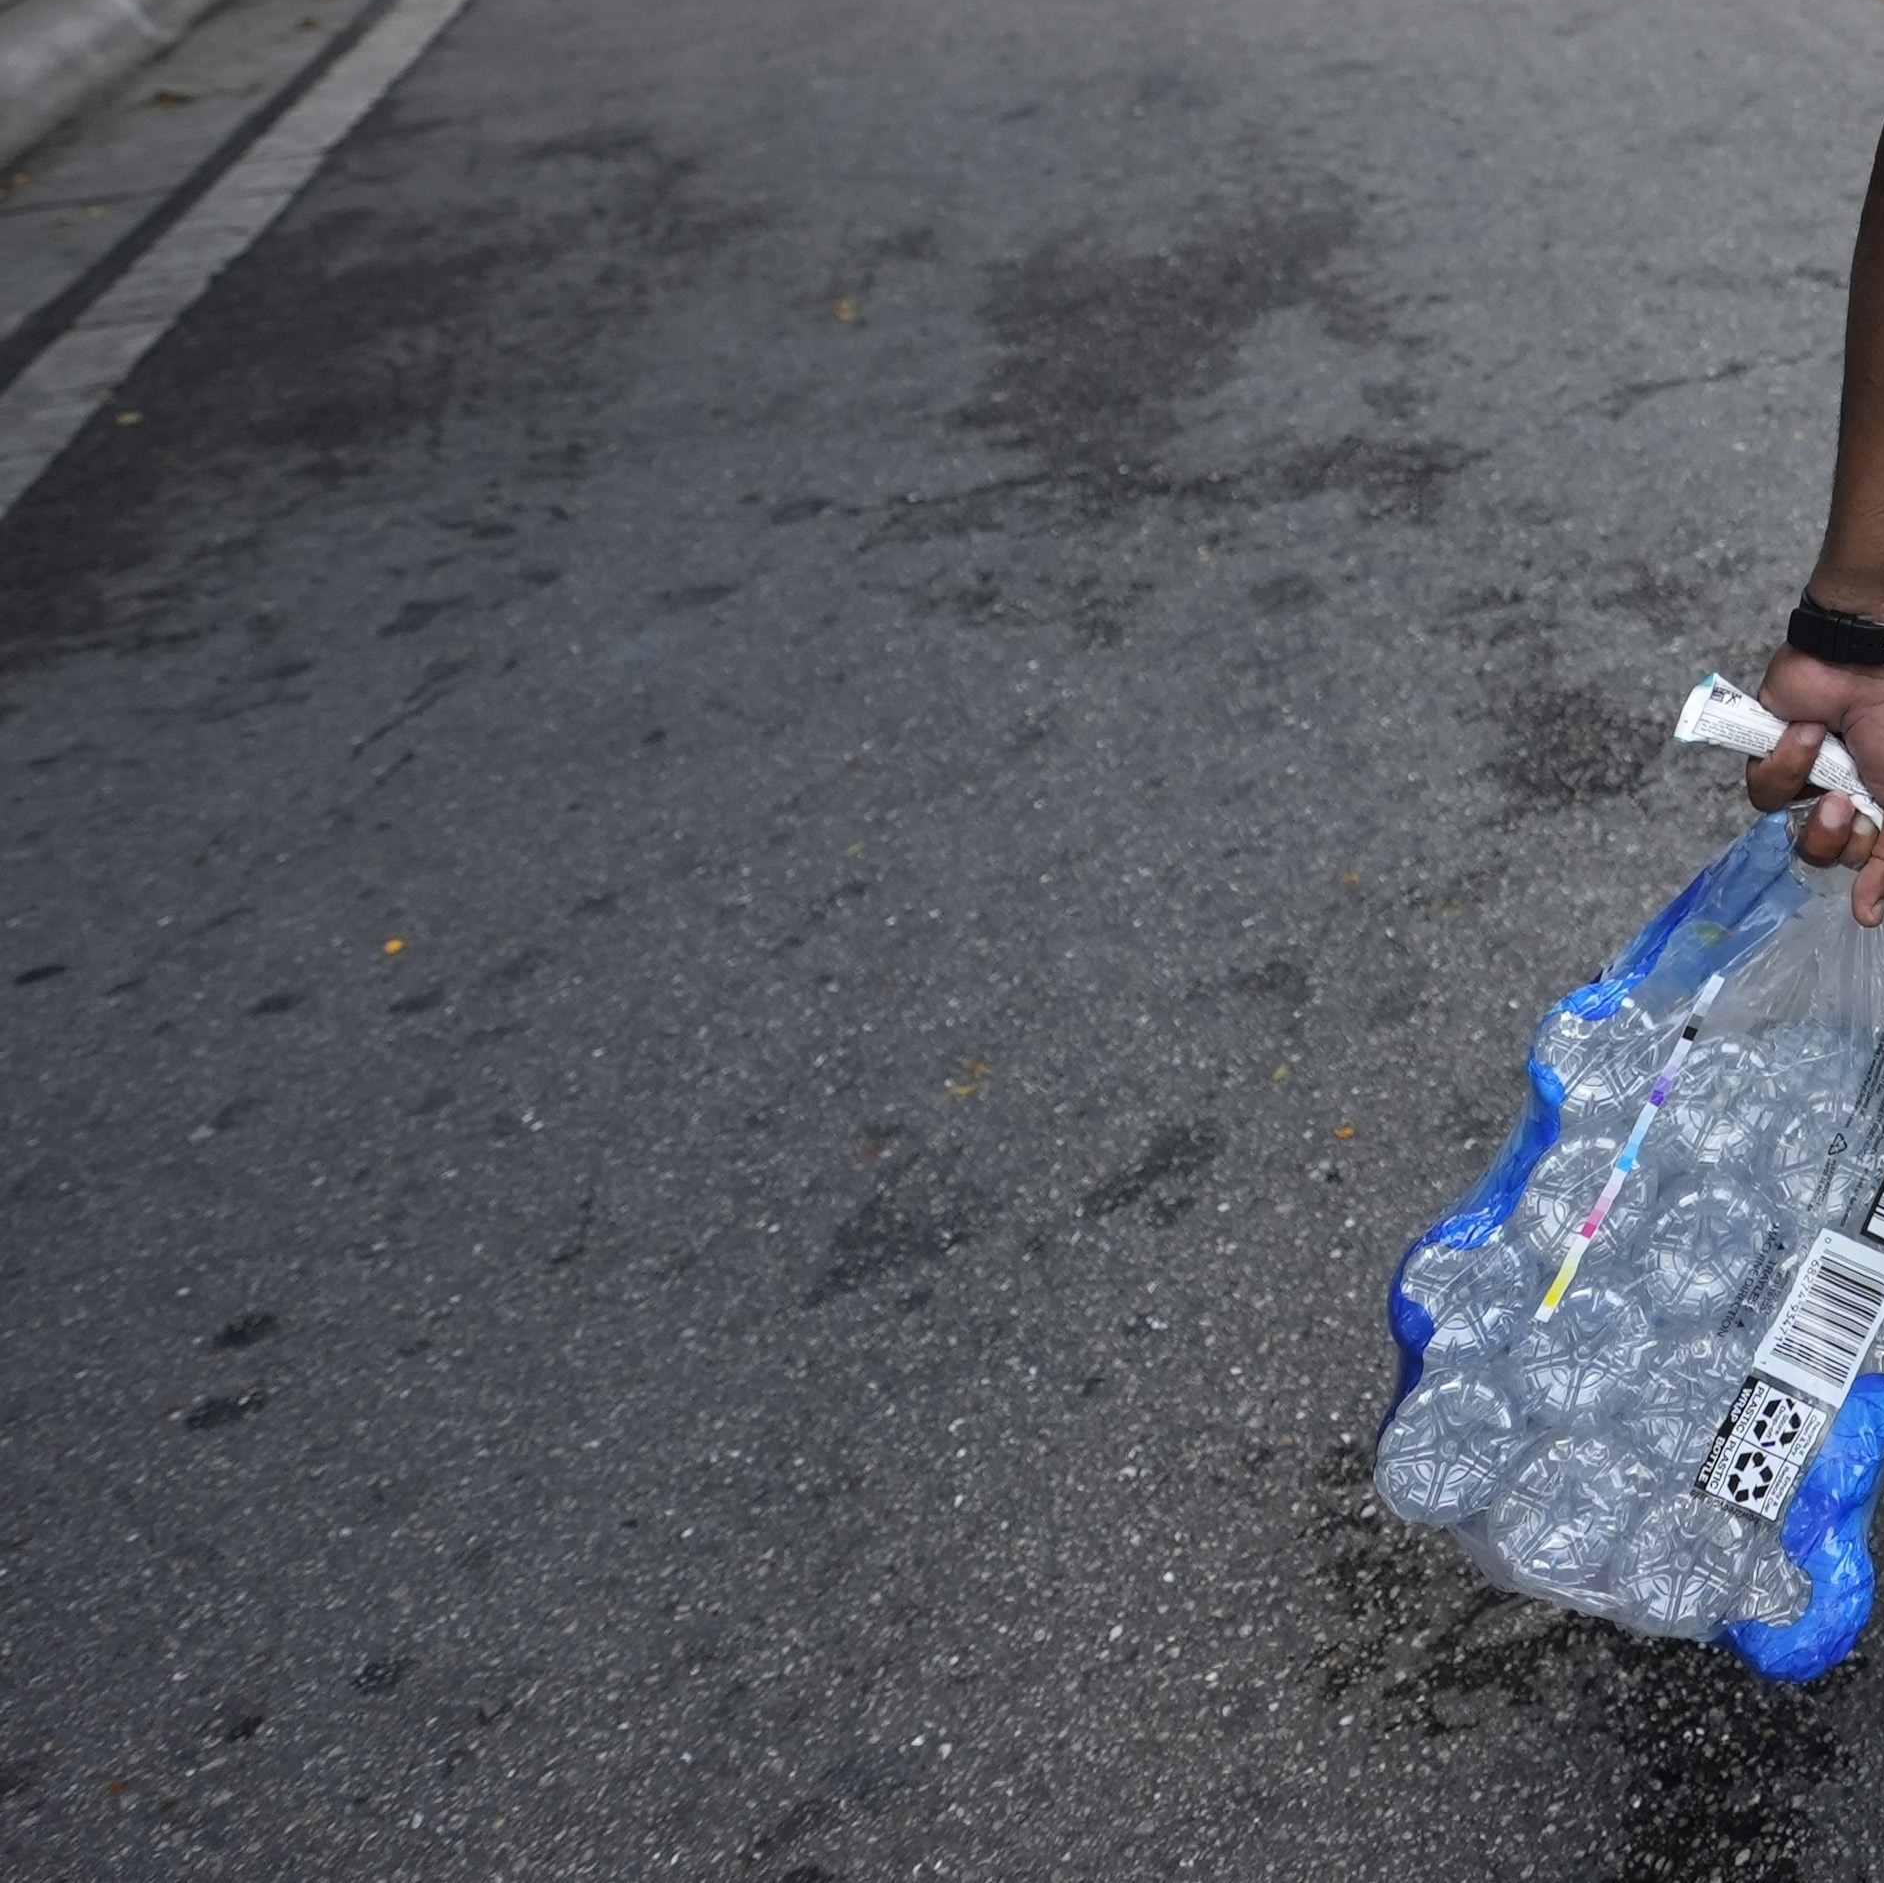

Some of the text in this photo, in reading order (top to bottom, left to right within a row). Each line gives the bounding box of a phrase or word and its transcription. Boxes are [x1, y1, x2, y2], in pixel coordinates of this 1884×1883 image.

[1747, 1223, 1781, 1277] MACHINE
[1823, 1236, 1832, 1244] 0
[1743, 1259, 1776, 1313] TRAYLESS
[1794, 1258, 1822, 1300] 68274
[1715, 1276, 1753, 1339] DIRECTION
[1773, 1302, 1800, 1342] 93471
[1727, 1385, 1752, 1423] WRAP
[1735, 1385, 1764, 1434] PLASTIC
[1765, 1404, 1786, 1439] Drop-off
[1774, 1413, 1788, 1436] Store
[1697, 1435, 1726, 1484] BOTTLE
[1708, 1439, 1735, 1489] PLASTIC
[1790, 1443, 1801, 1457] Dry
[1775, 1475, 1791, 1500] Empty
